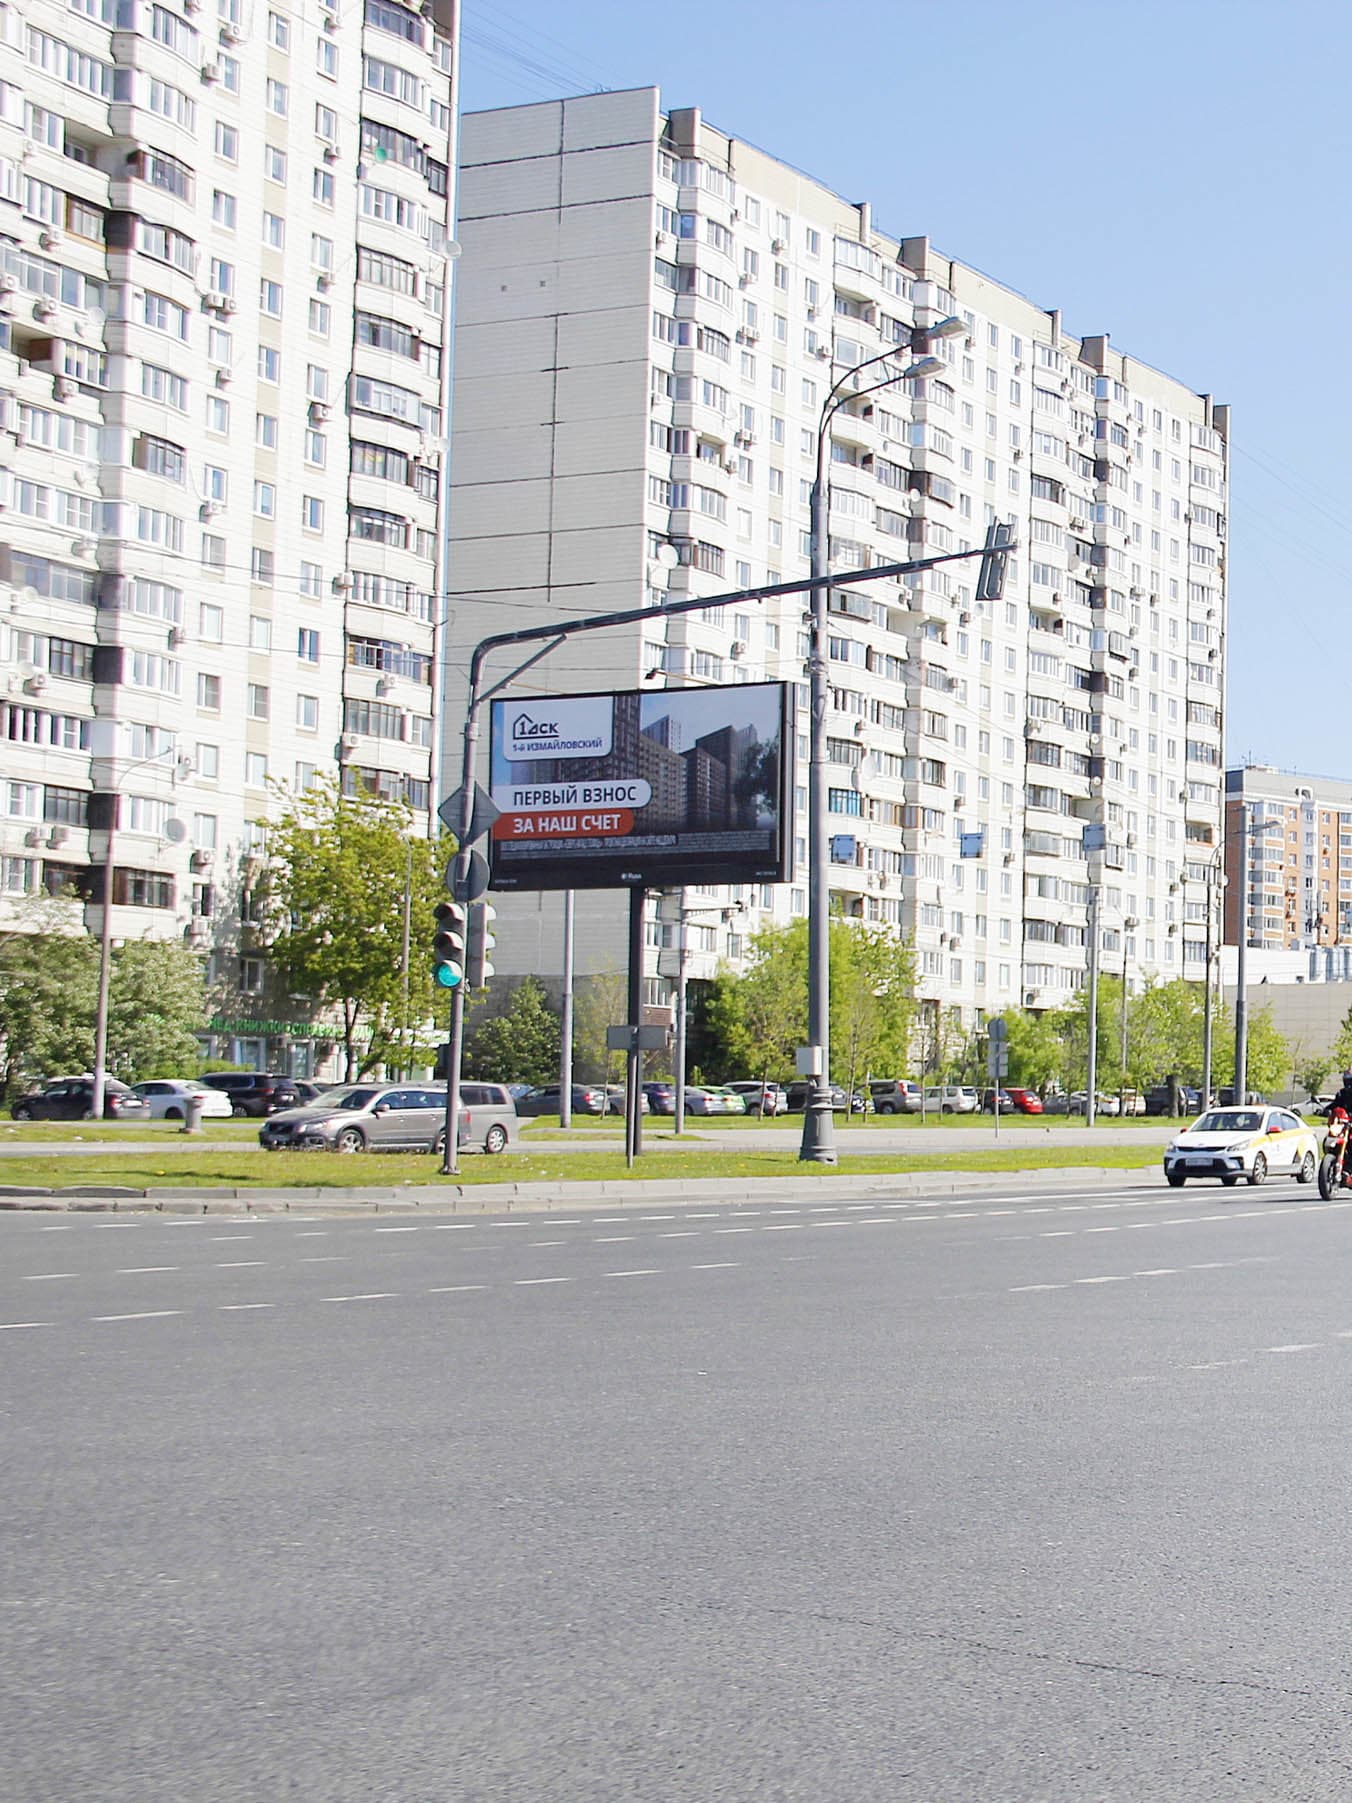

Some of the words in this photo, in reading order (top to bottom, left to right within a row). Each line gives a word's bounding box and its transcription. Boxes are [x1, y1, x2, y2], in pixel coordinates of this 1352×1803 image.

[527, 737, 603, 752] ИЗМАЙЛОВСКИЙ
[513, 785, 577, 806] ПЕРВЫЙ
[583, 786, 637, 803] ВЗНОС
[513, 818, 535, 833] ЗА
[539, 816, 577, 832] НАШ
[581, 814, 621, 830] СЧЕТ
